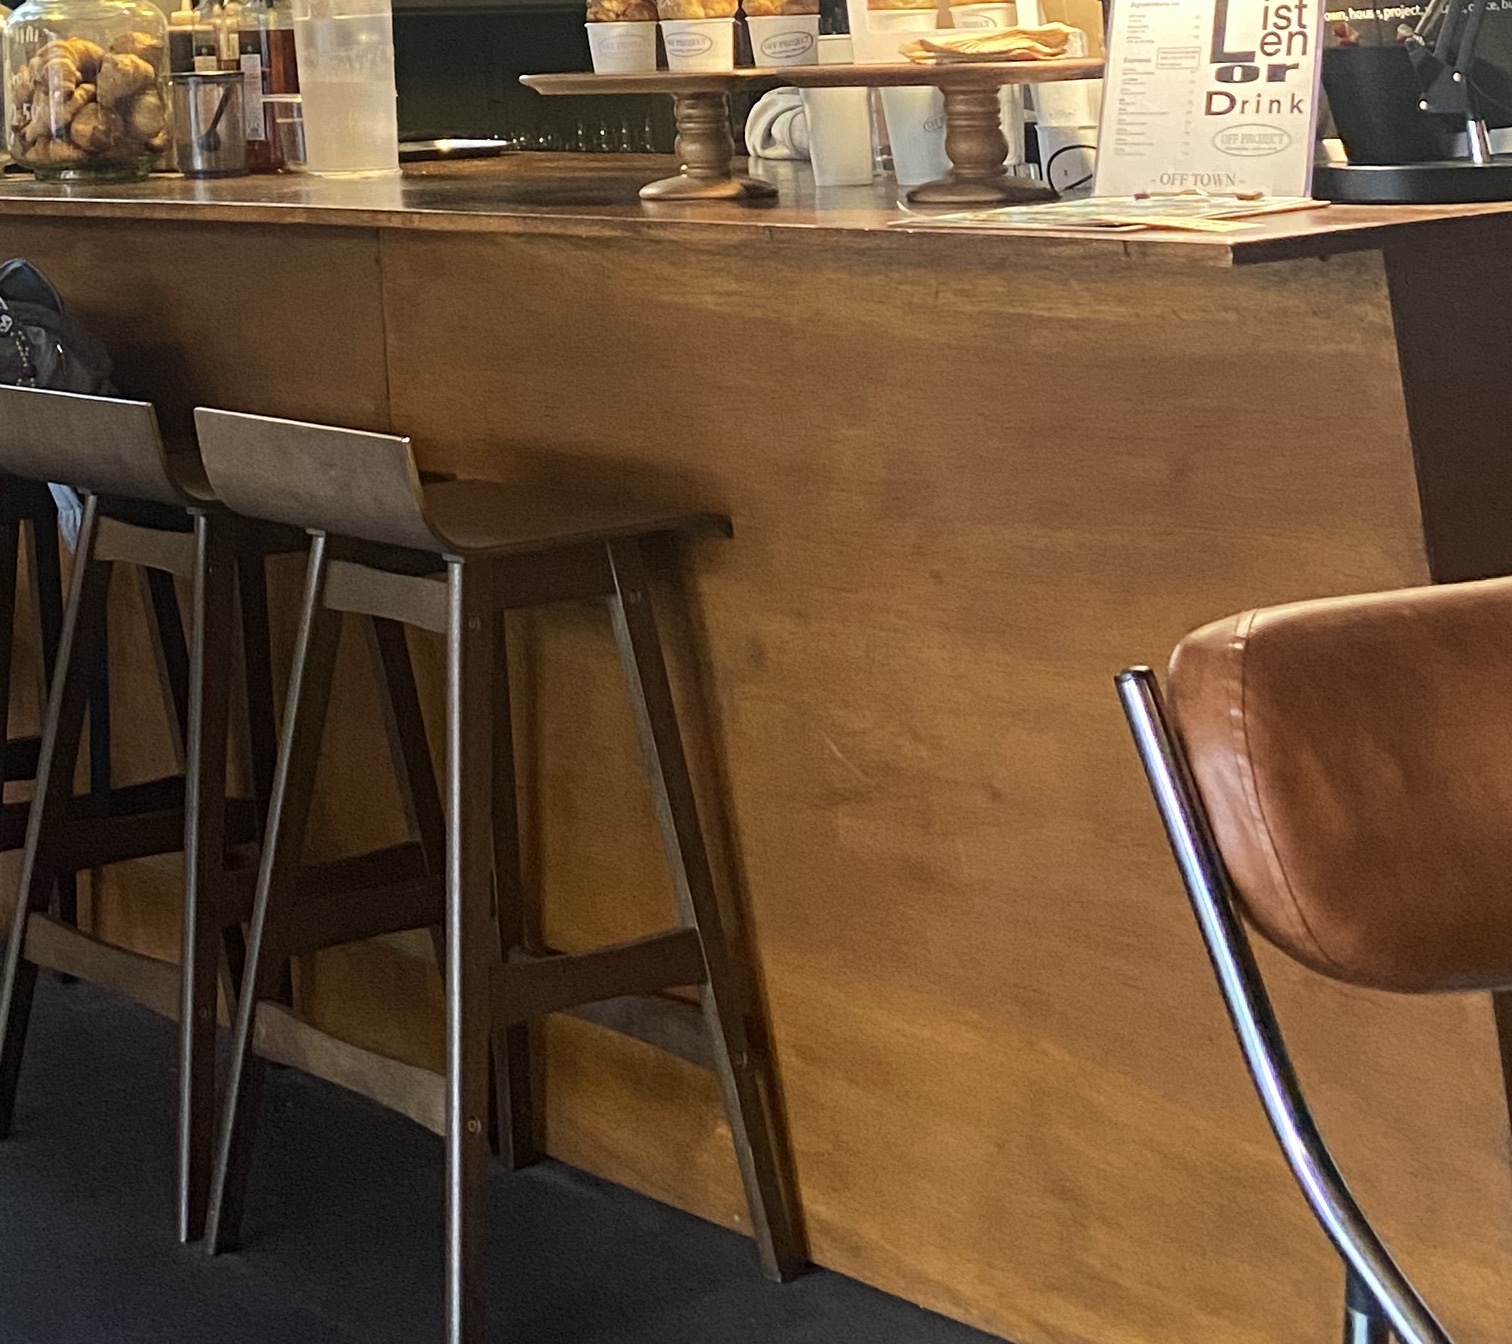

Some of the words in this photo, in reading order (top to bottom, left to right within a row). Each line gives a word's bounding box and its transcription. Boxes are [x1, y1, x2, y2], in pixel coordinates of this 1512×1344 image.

[1214, 63, 1299, 84] or
[1204, 90, 1305, 116] Drink
[1159, 173, 1188, 186] OFF
[1190, 173, 1236, 187] TOWN
